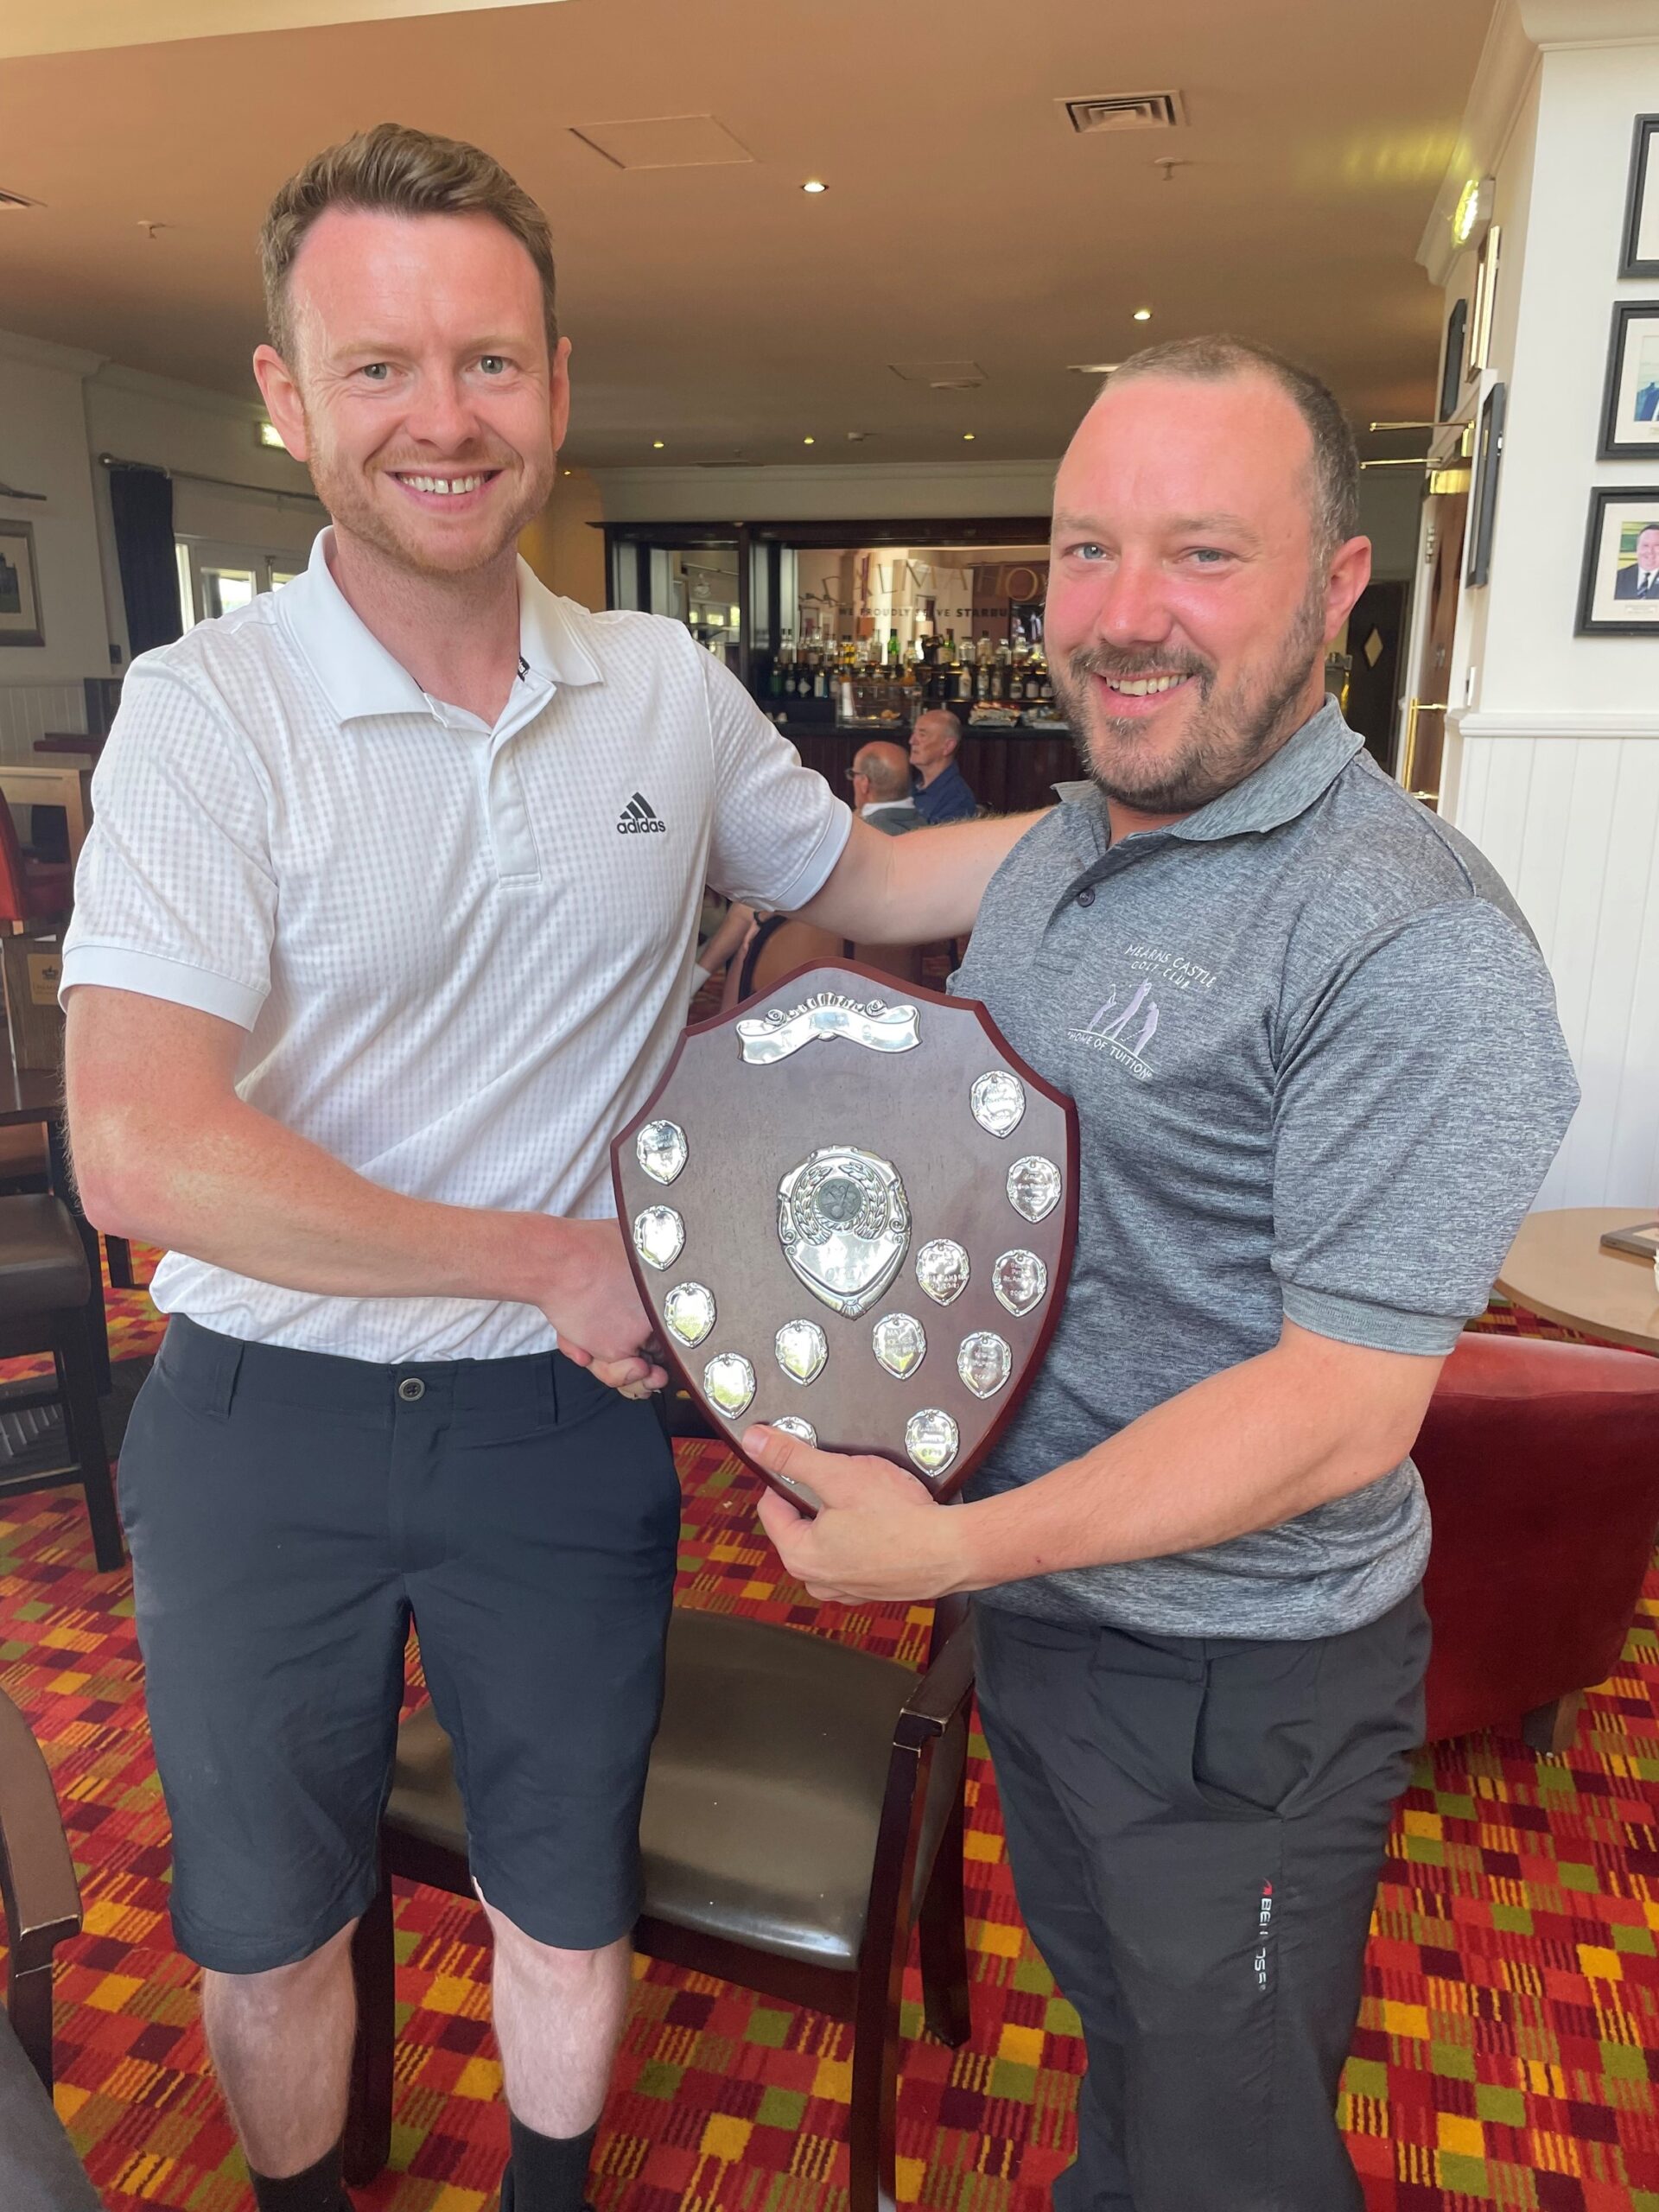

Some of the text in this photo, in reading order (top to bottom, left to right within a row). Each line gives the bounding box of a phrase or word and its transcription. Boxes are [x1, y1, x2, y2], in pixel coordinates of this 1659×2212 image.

[861, 607, 910, 617] PROUDLY
[915, 607, 950, 617] SEVE
[617, 818, 666, 834] adidas
[1124, 944, 1217, 988] MEARNS CASTLE
[1094, 1039, 1108, 1051] OF
